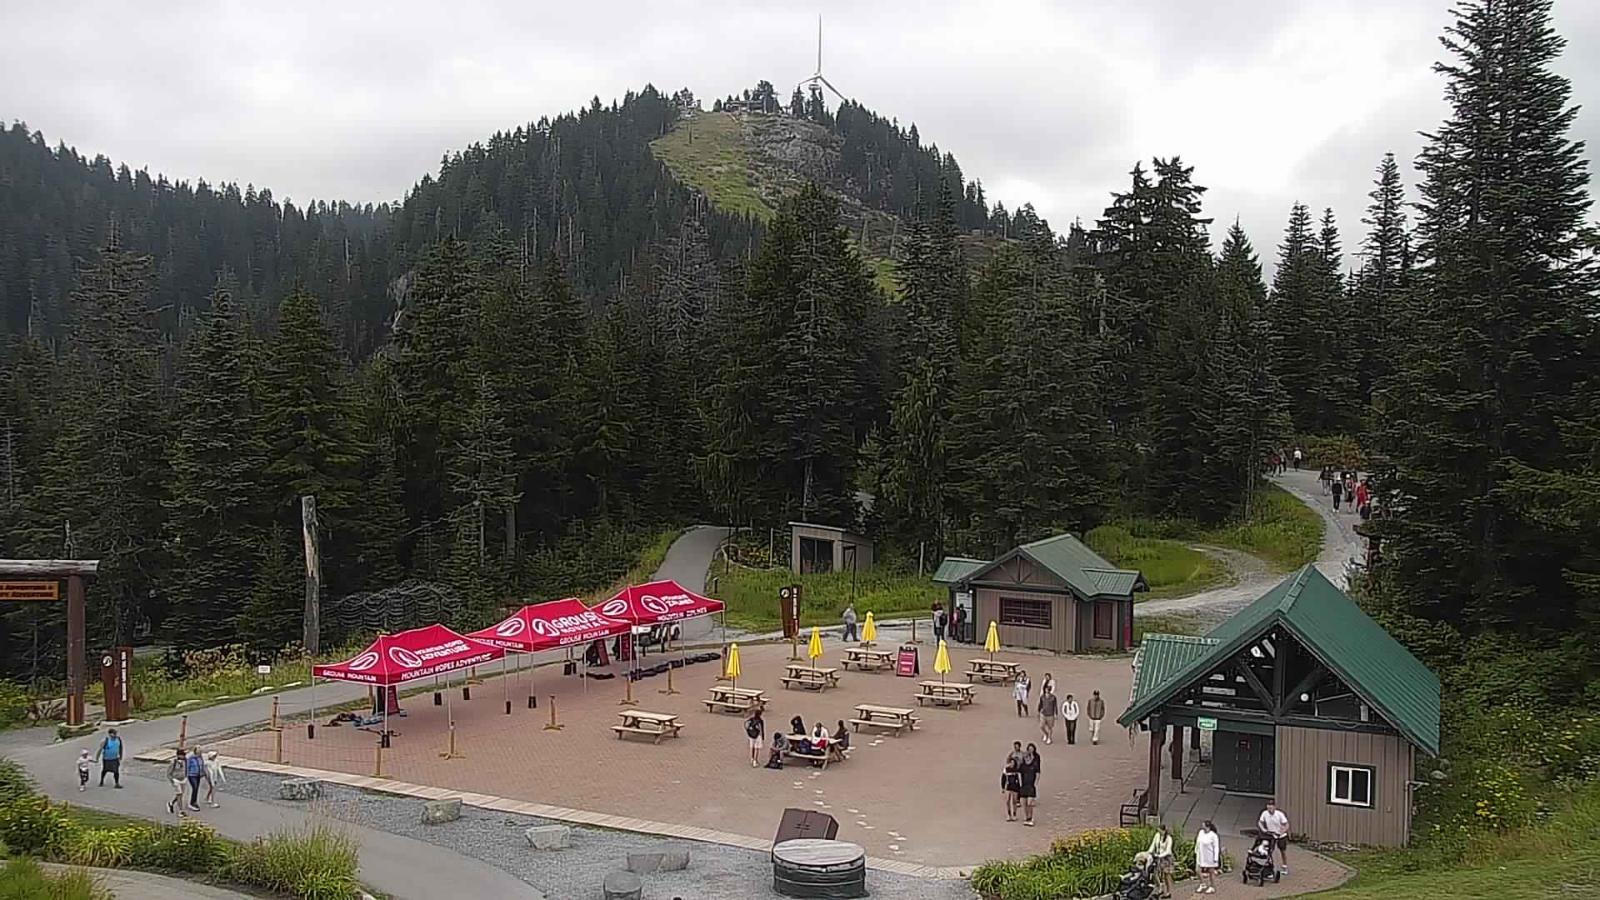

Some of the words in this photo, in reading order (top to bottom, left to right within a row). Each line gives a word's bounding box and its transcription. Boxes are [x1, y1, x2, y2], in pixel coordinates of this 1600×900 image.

[559, 634, 582, 645] GROUSE
[582, 629, 610, 640] MOUNTAIN
[495, 639, 524, 649] MOUNTAIN
[346, 672, 377, 682] MOUNTAIN
[401, 667, 434, 680] MOUNTAIN
[435, 661, 455, 672] ROPES
